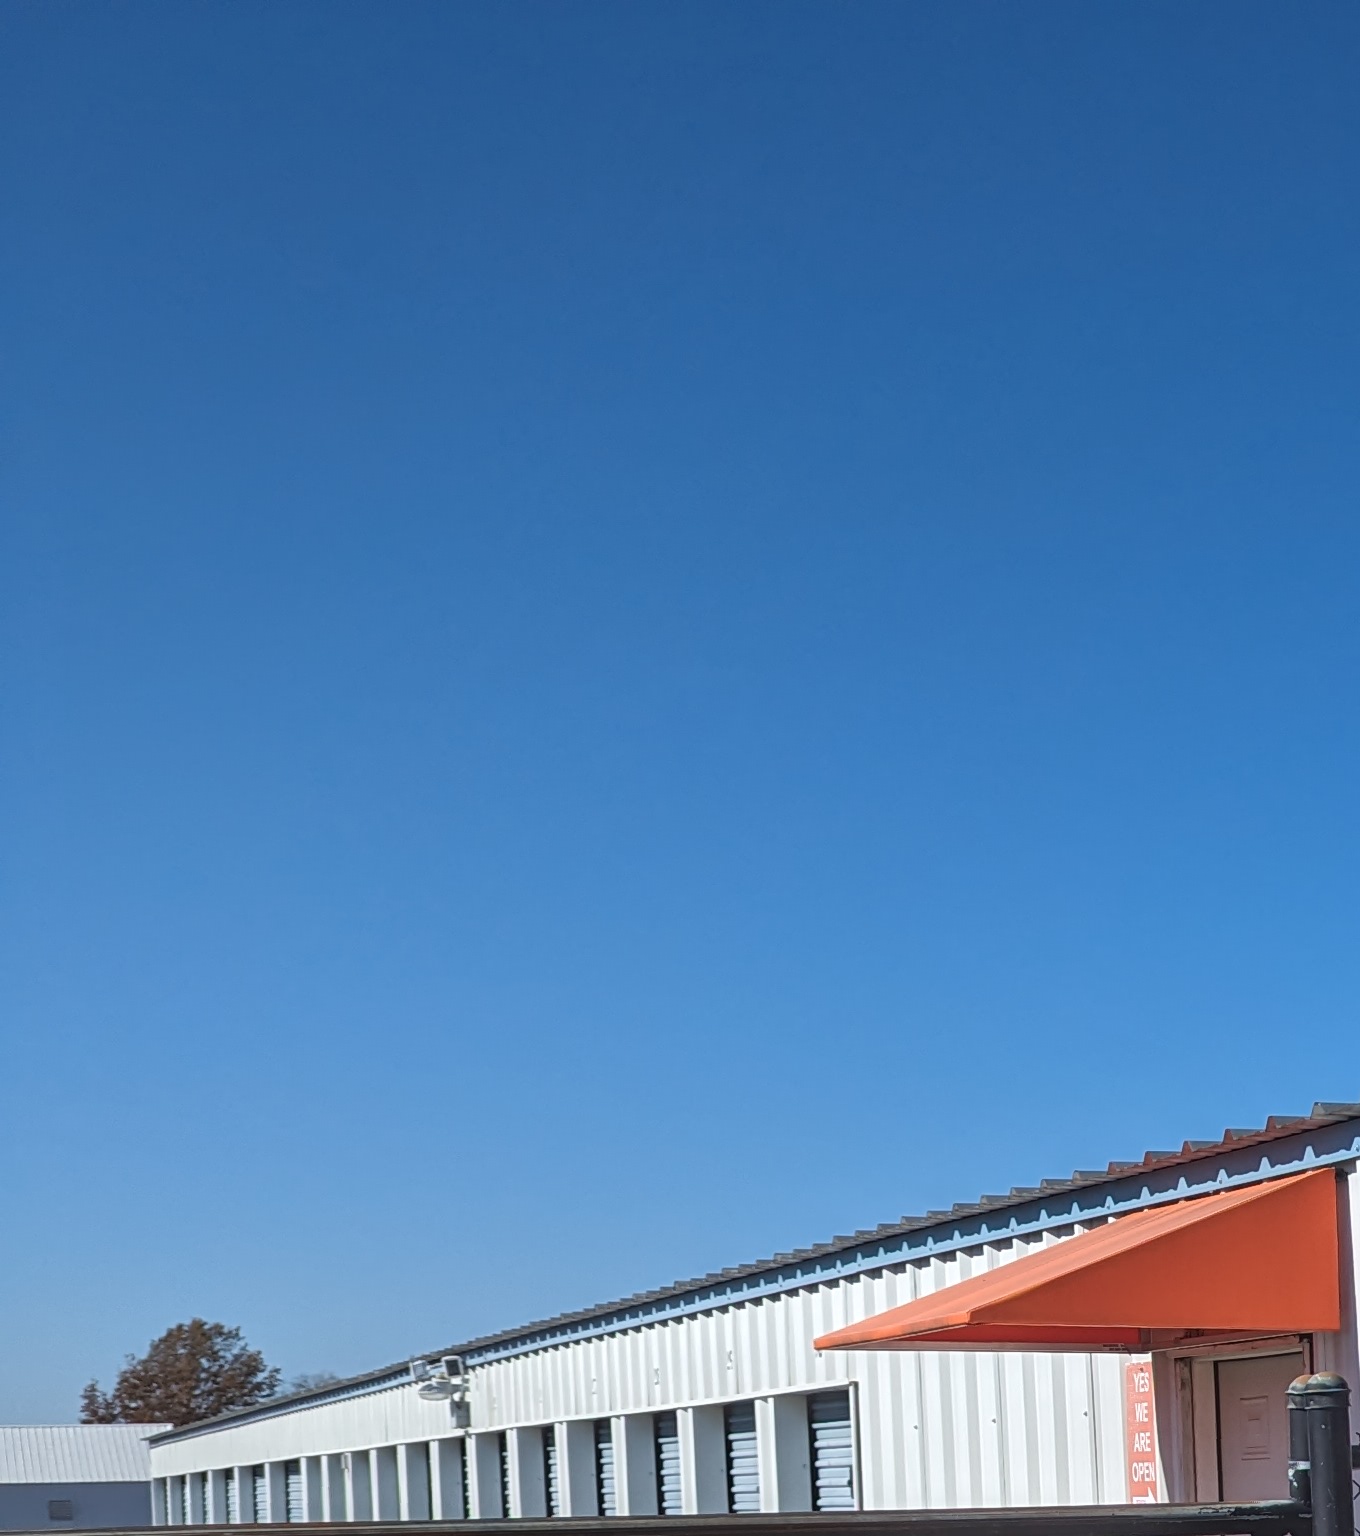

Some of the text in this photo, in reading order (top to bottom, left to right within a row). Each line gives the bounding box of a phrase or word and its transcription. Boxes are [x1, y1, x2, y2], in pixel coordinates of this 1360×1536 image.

[1133, 1372, 1150, 1393] YES
[1134, 1402, 1149, 1422] WE
[1133, 1432, 1152, 1452] ARE
[1132, 1461, 1155, 1482] OPEN
